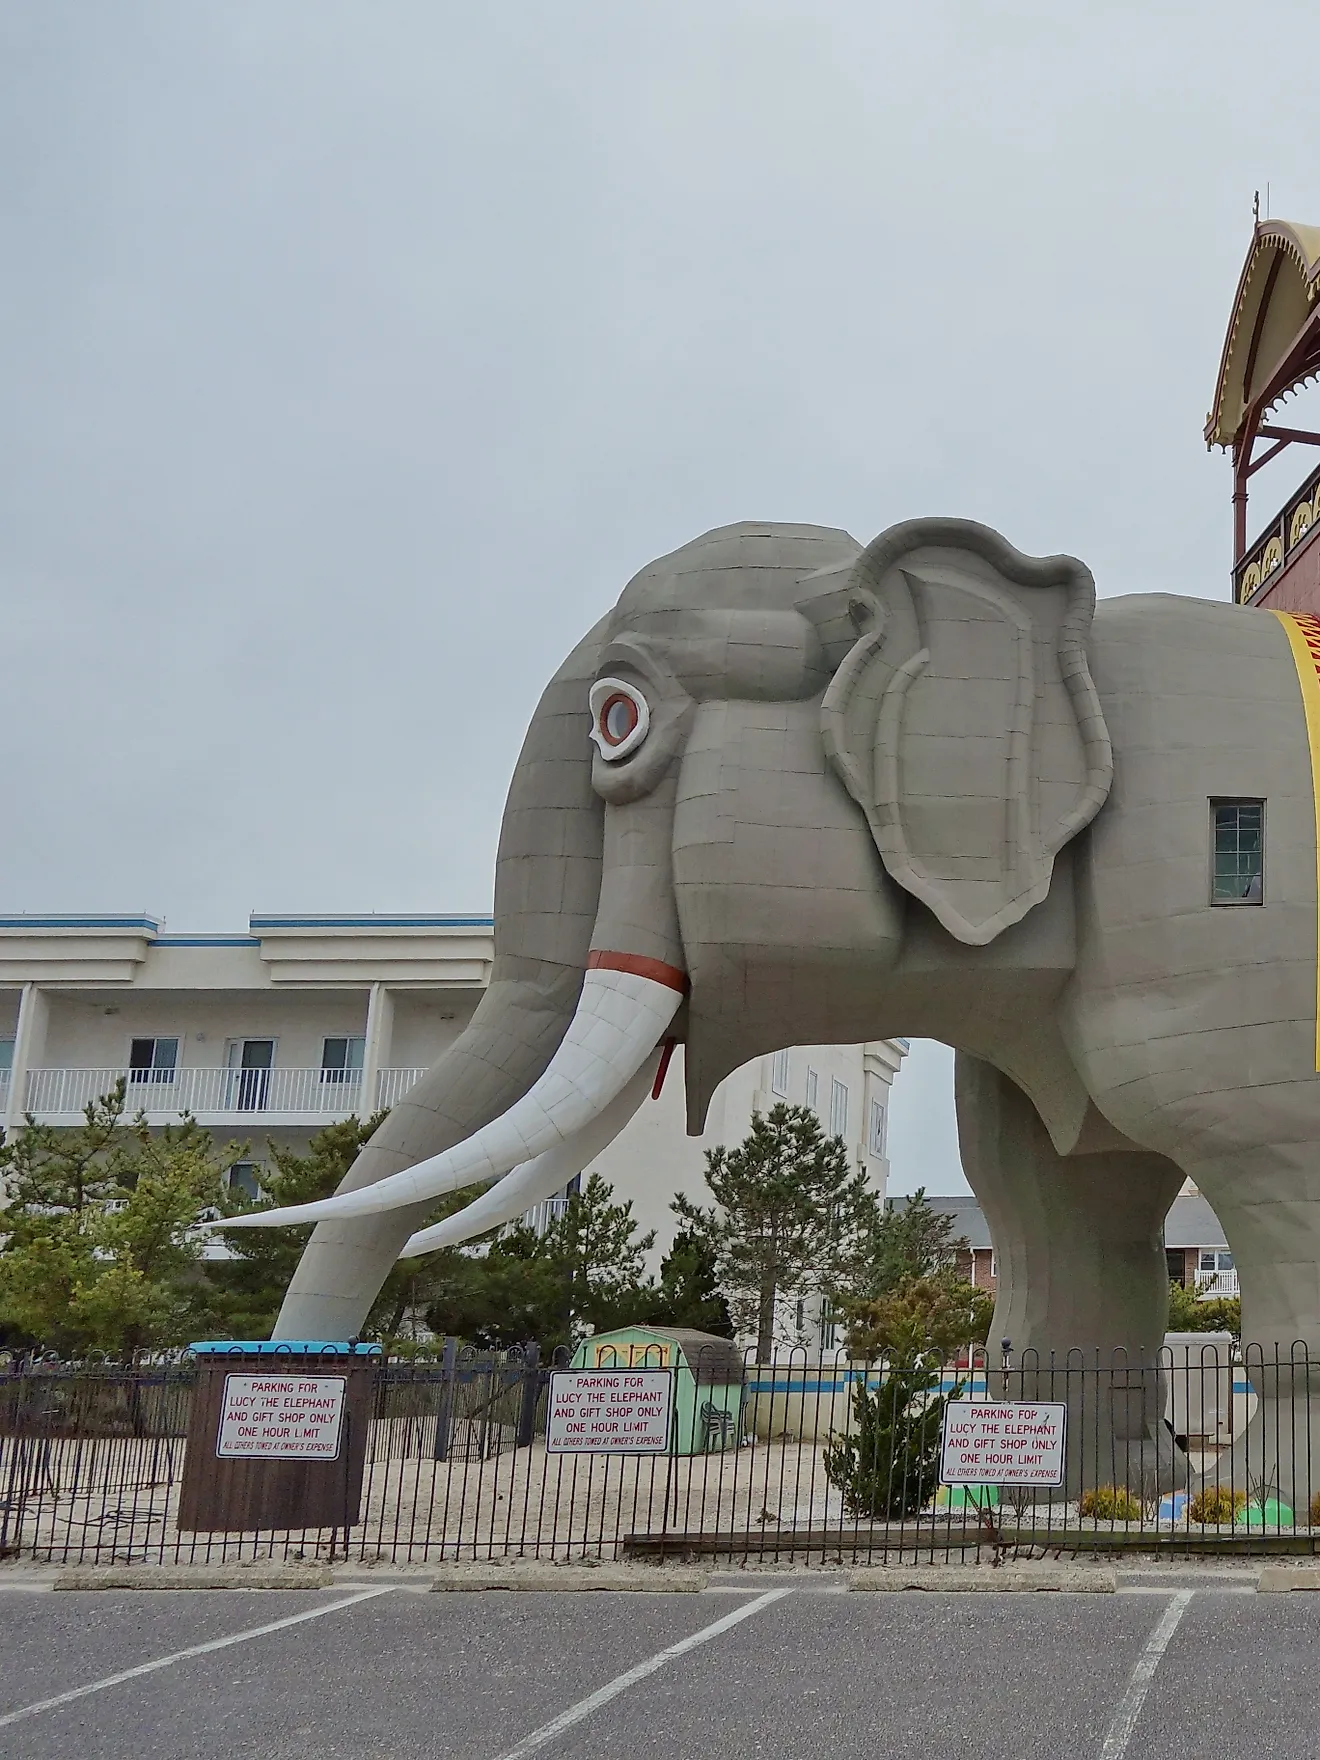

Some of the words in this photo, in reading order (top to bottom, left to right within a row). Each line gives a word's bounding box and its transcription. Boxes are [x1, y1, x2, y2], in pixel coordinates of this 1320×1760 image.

[251, 1382, 293, 1393] PARKING
[298, 1383, 318, 1393] FOR
[576, 1378, 619, 1388] PARKING
[624, 1378, 644, 1387] FOR
[229, 1397, 255, 1407] LUCY
[283, 1398, 336, 1409] ELEPHANT
[556, 1393, 582, 1403] LUCY
[587, 1392, 606, 1403] THE
[610, 1392, 663, 1402] ELEPHANT
[227, 1412, 247, 1421] AND
[252, 1412, 274, 1422] GIFT
[278, 1413, 305, 1423] SHOP
[309, 1413, 336, 1424] ONLY
[553, 1408, 575, 1418] AND
[580, 1408, 601, 1417] GIFT
[605, 1407, 633, 1417] SHOP
[637, 1407, 663, 1417] ONLY
[971, 1409, 1014, 1419] PARKING
[238, 1427, 258, 1437] ONE
[262, 1427, 290, 1437] HOUR
[294, 1428, 320, 1438] LMIT
[566, 1423, 586, 1432] ONE
[591, 1422, 618, 1432] HOUR
[623, 1422, 649, 1432] LIMIT
[950, 1424, 976, 1433] LUCY
[981, 1424, 1000, 1434] THE
[1004, 1425, 1057, 1435] ELEPHANT
[948, 1438, 969, 1448] AND
[974, 1439, 995, 1449] GIFT
[1000, 1439, 1027, 1449] SHOP
[1032, 1440, 1057, 1450] ONLY
[960, 1454, 980, 1463] ONE
[985, 1454, 1013, 1464] HOUR
[1018, 1455, 1043, 1465] LIMIT
